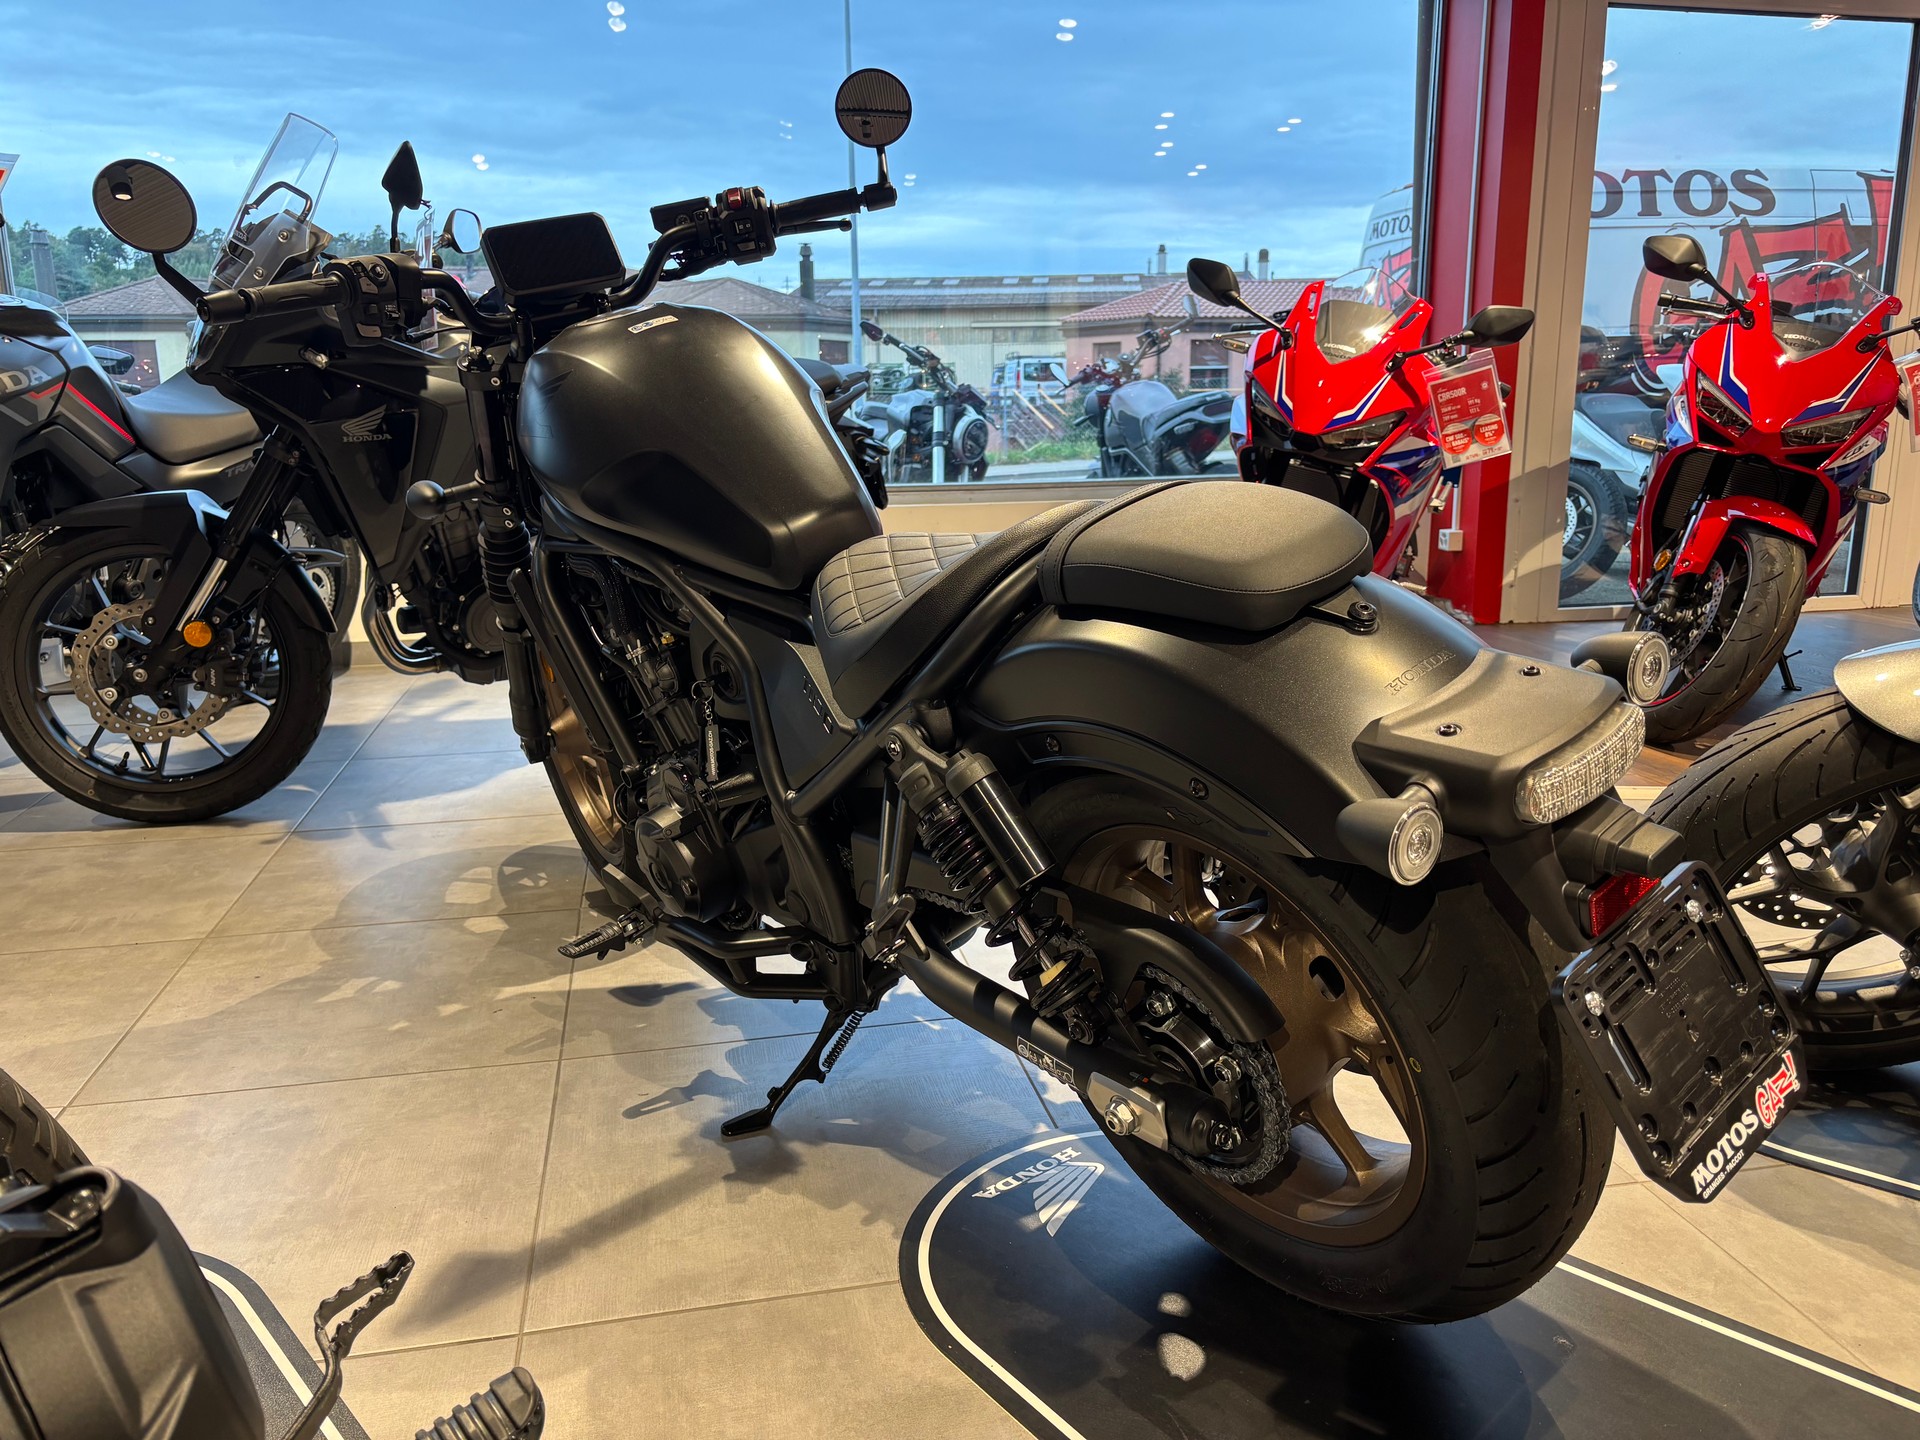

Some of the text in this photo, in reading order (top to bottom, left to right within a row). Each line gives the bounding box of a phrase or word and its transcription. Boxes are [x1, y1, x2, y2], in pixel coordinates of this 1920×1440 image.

[1590, 168, 1776, 219] OTOS
[1369, 214, 1412, 240] MOTO
[1783, 333, 1822, 346] HONDA
[342, 432, 393, 443] HONDA
[1383, 648, 1457, 697] HONDA
[1690, 1049, 1801, 1195] MOTOS GAZ!
[971, 1146, 1082, 1199] HONDA
